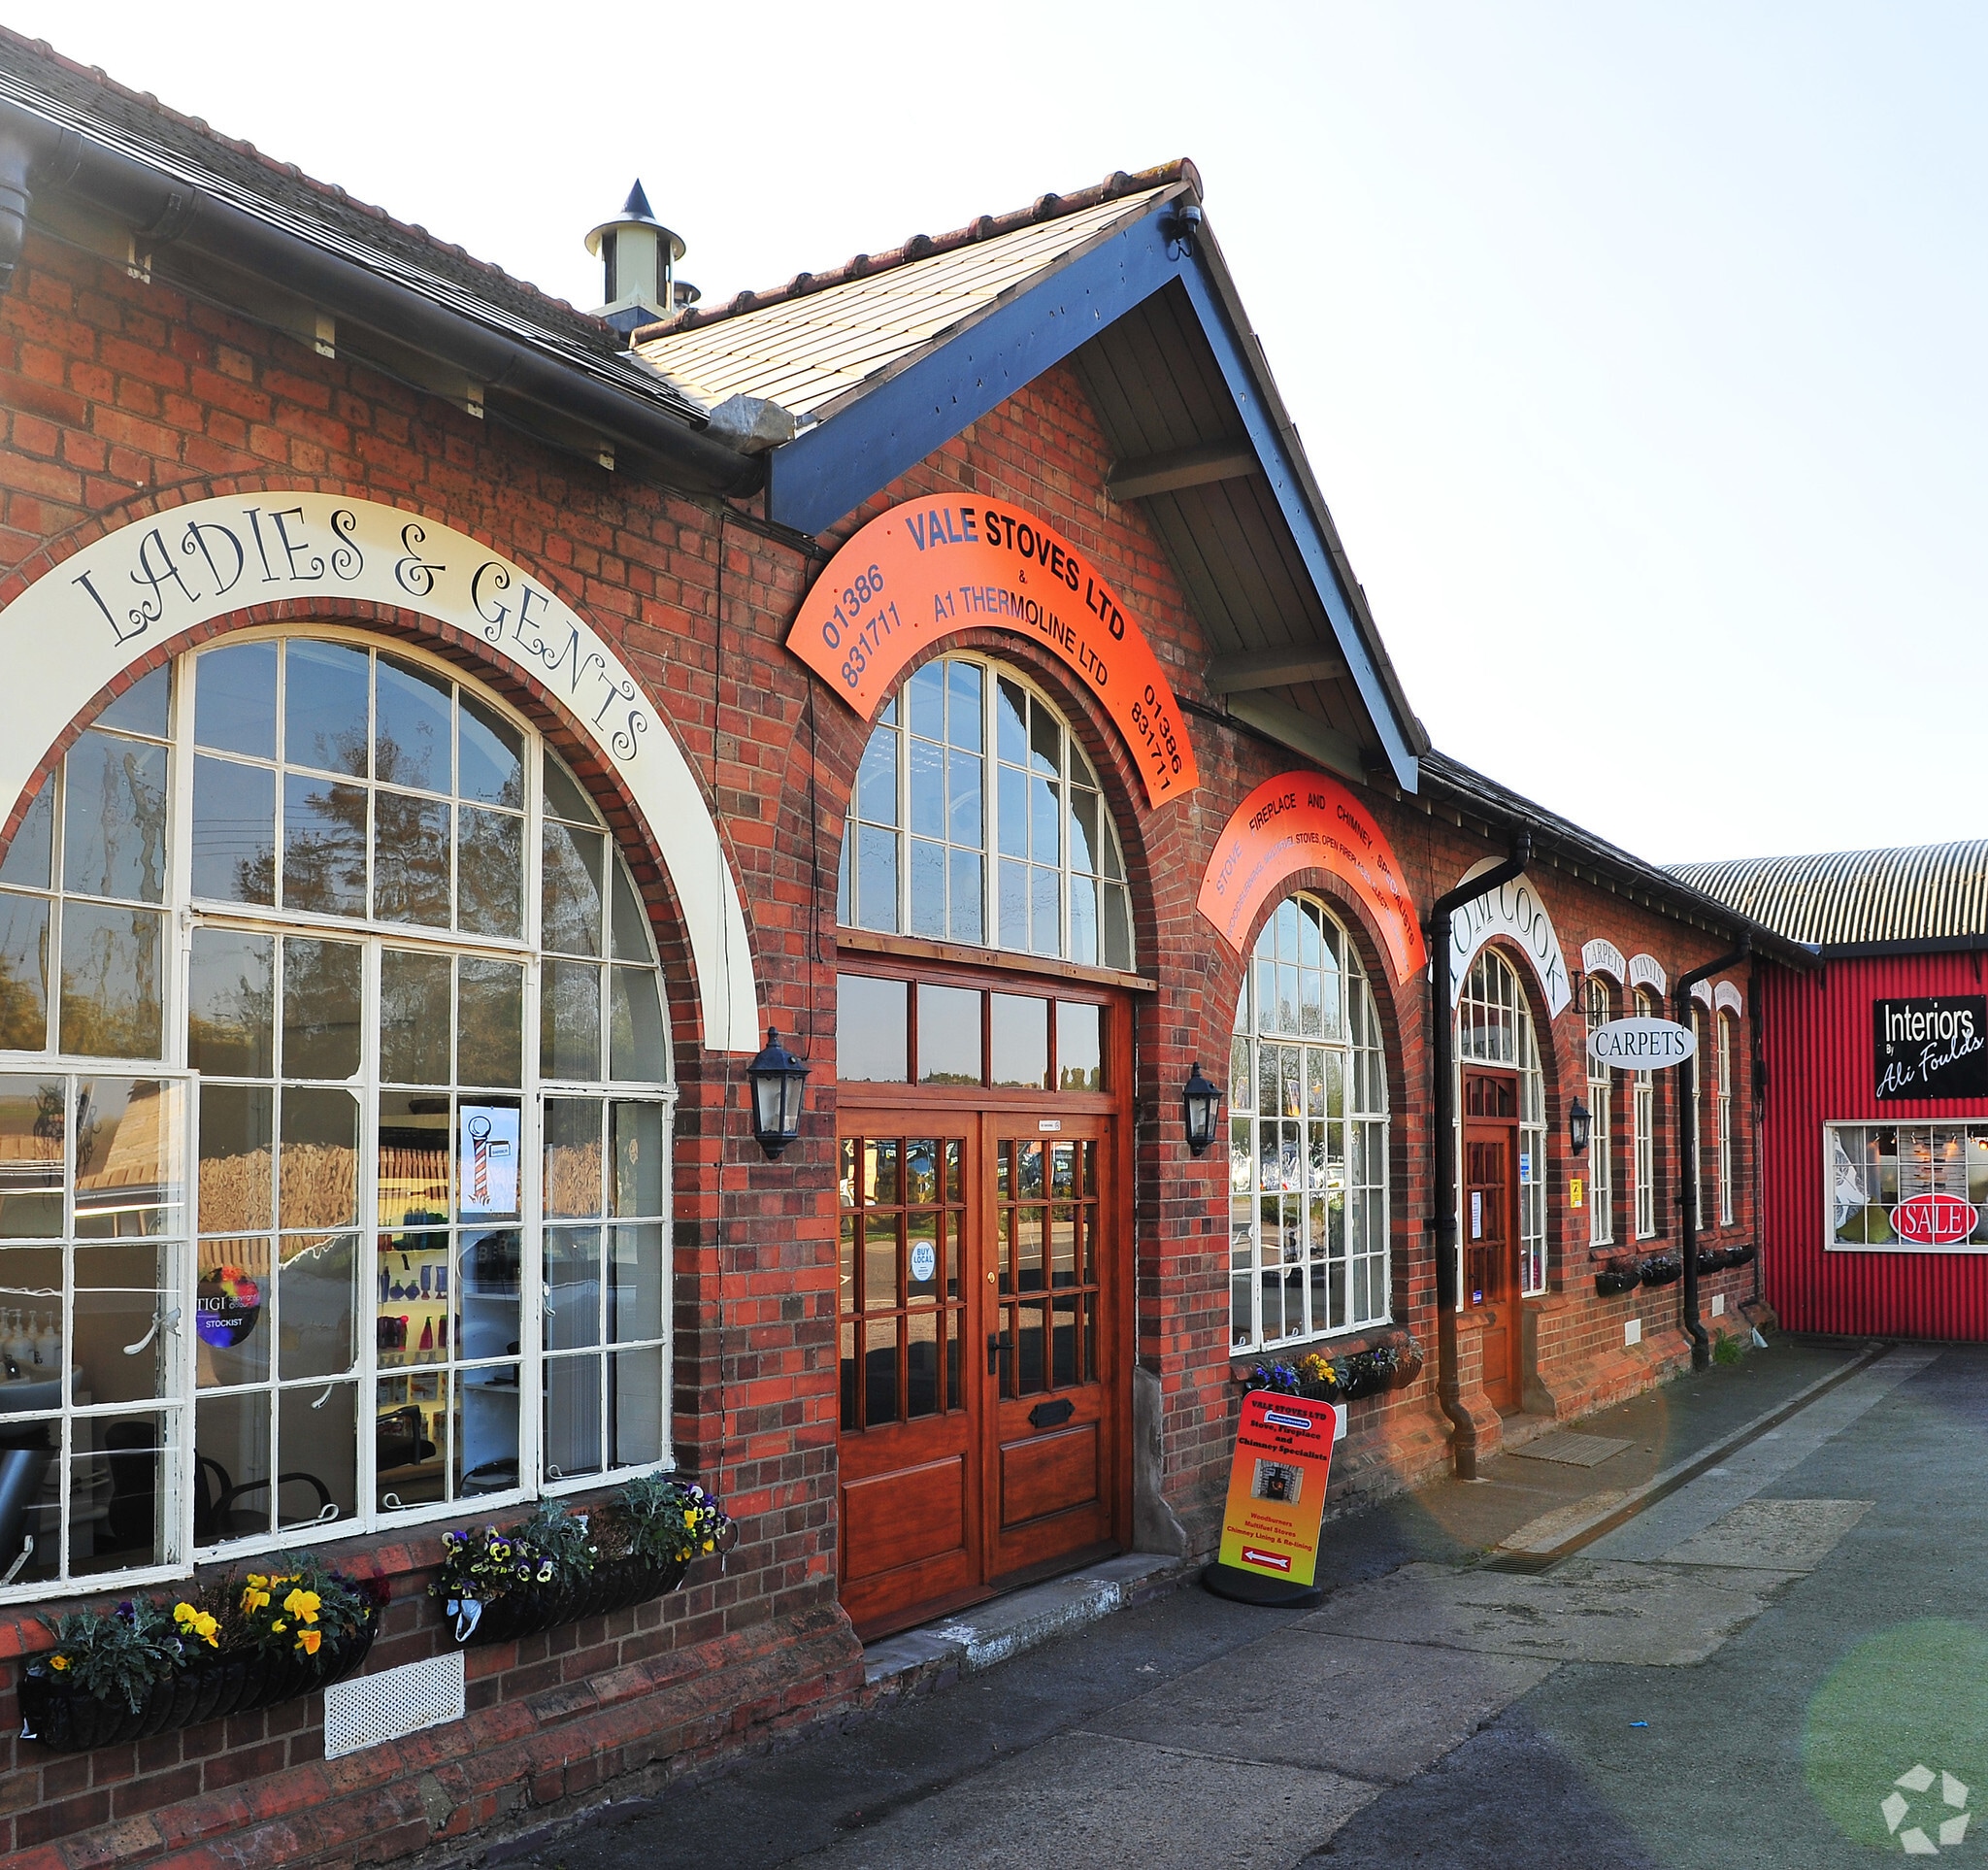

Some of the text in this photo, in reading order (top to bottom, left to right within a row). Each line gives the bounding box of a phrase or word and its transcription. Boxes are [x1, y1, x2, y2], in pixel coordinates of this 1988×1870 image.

[905, 507, 1126, 642] VALE STOVES LTD
[1018, 569, 1028, 584] &
[821, 563, 884, 651] 01386
[71, 507, 648, 761] LADIES & GENTS
[841, 601, 903, 689] 831711
[934, 585, 1109, 686] A1 THERMOLINE LTD
[1143, 684, 1182, 775] 01386
[1131, 701, 1171, 791] 831711
[1321, 835, 1339, 851] OPEN
[1216, 792, 1415, 946] STOVE FIREPLACE AND CHIMNEY SPECIALISTS
[1500, 879, 1564, 1007] COOK
[1585, 943, 1624, 979] CARPETS
[1634, 957, 1662, 986] VINYLS
[1884, 1002, 1974, 1042] Interiors
[1595, 1030, 1685, 1056] CARPETS
[1886, 1044, 1894, 1056] By
[1876, 1029, 1985, 1098] Ali Foulds
[1905, 1205, 1964, 1234] SALE
[197, 1297, 225, 1311] TIGI
[206, 1319, 243, 1328] STOCKIST
[1252, 1400, 1326, 1420] VALE STOVES LTD
[1250, 1419, 1321, 1440] Stove, Fireplace
[1239, 1437, 1327, 1461] Chimney Specialists
[1244, 1520, 1296, 1538] Multifuel Stoves
[1250, 1512, 1292, 1527] Woodburners
[1226, 1525, 1254, 1538] Chimney
[1255, 1532, 1276, 1543] Lining
[1283, 1539, 1312, 1552] Re-lining
